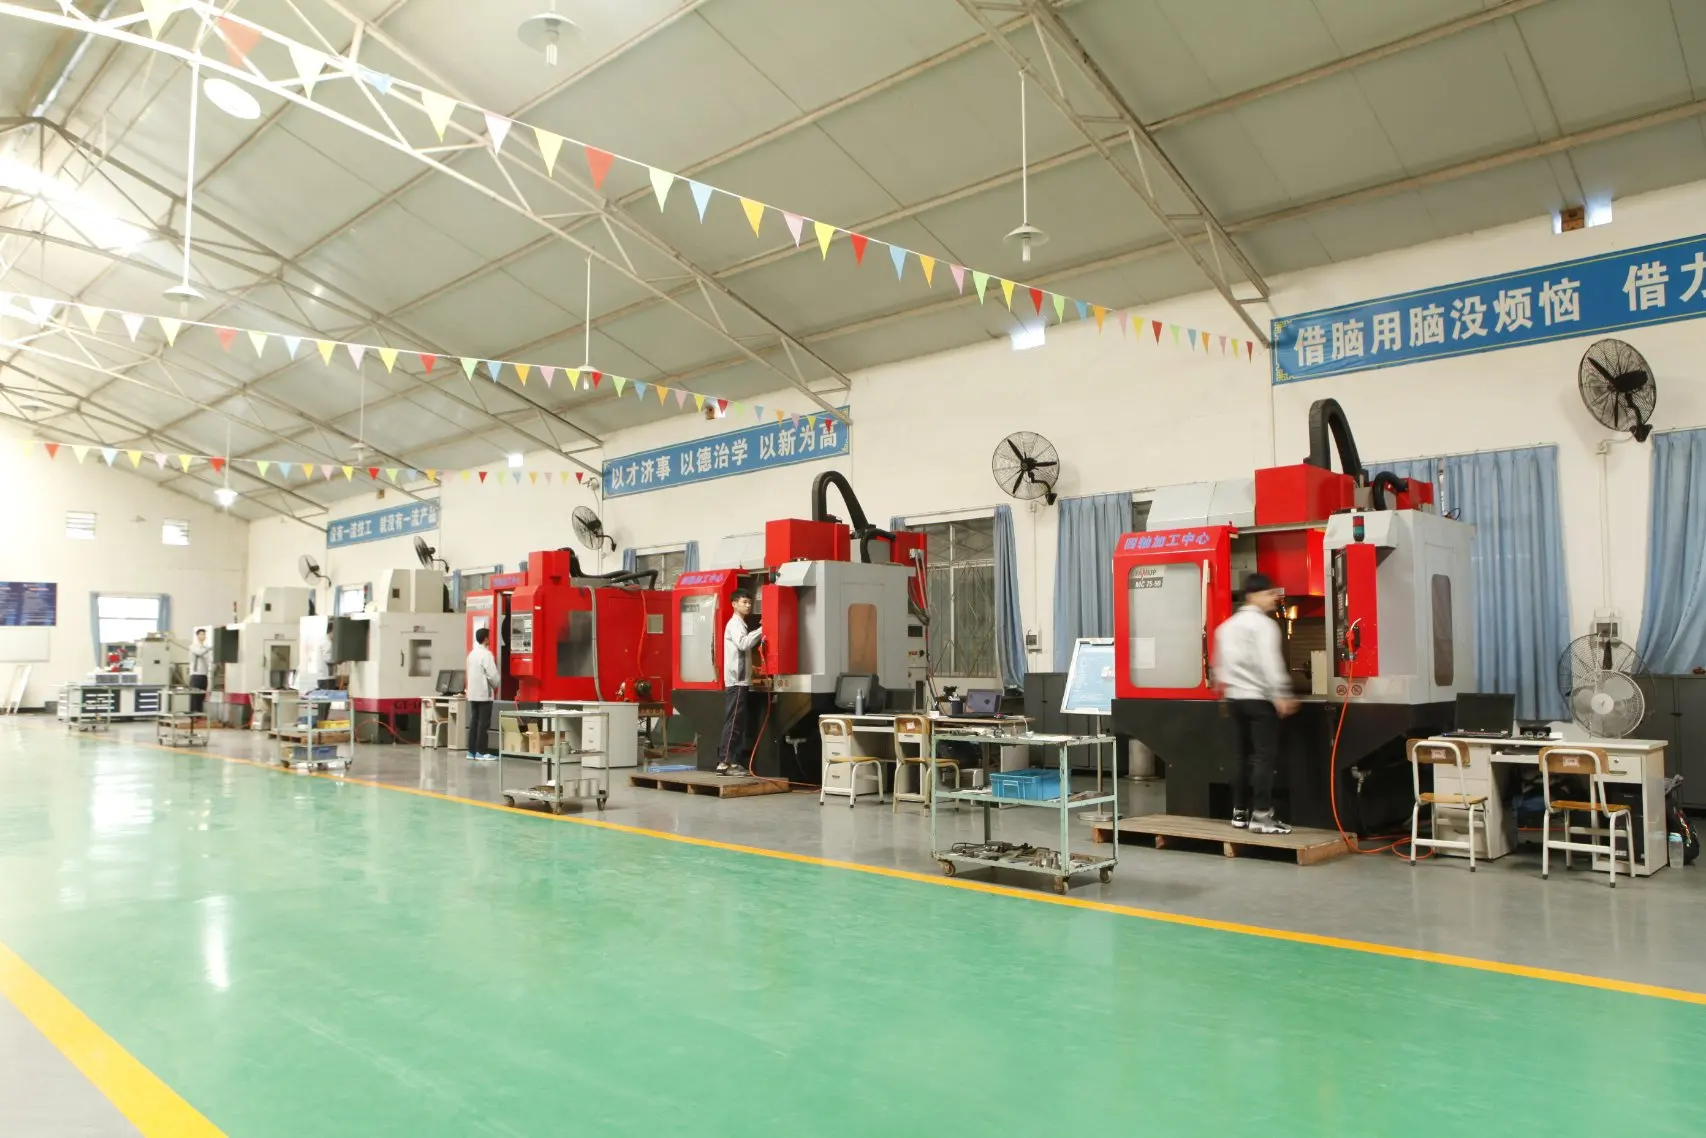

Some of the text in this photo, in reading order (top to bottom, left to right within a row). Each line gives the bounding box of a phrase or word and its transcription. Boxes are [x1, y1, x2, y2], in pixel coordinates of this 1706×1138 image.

[1293, 277, 1581, 368] 借脑用脑没烦恼
[611, 420, 838, 490] 以才济事 以德治学 以新为高
